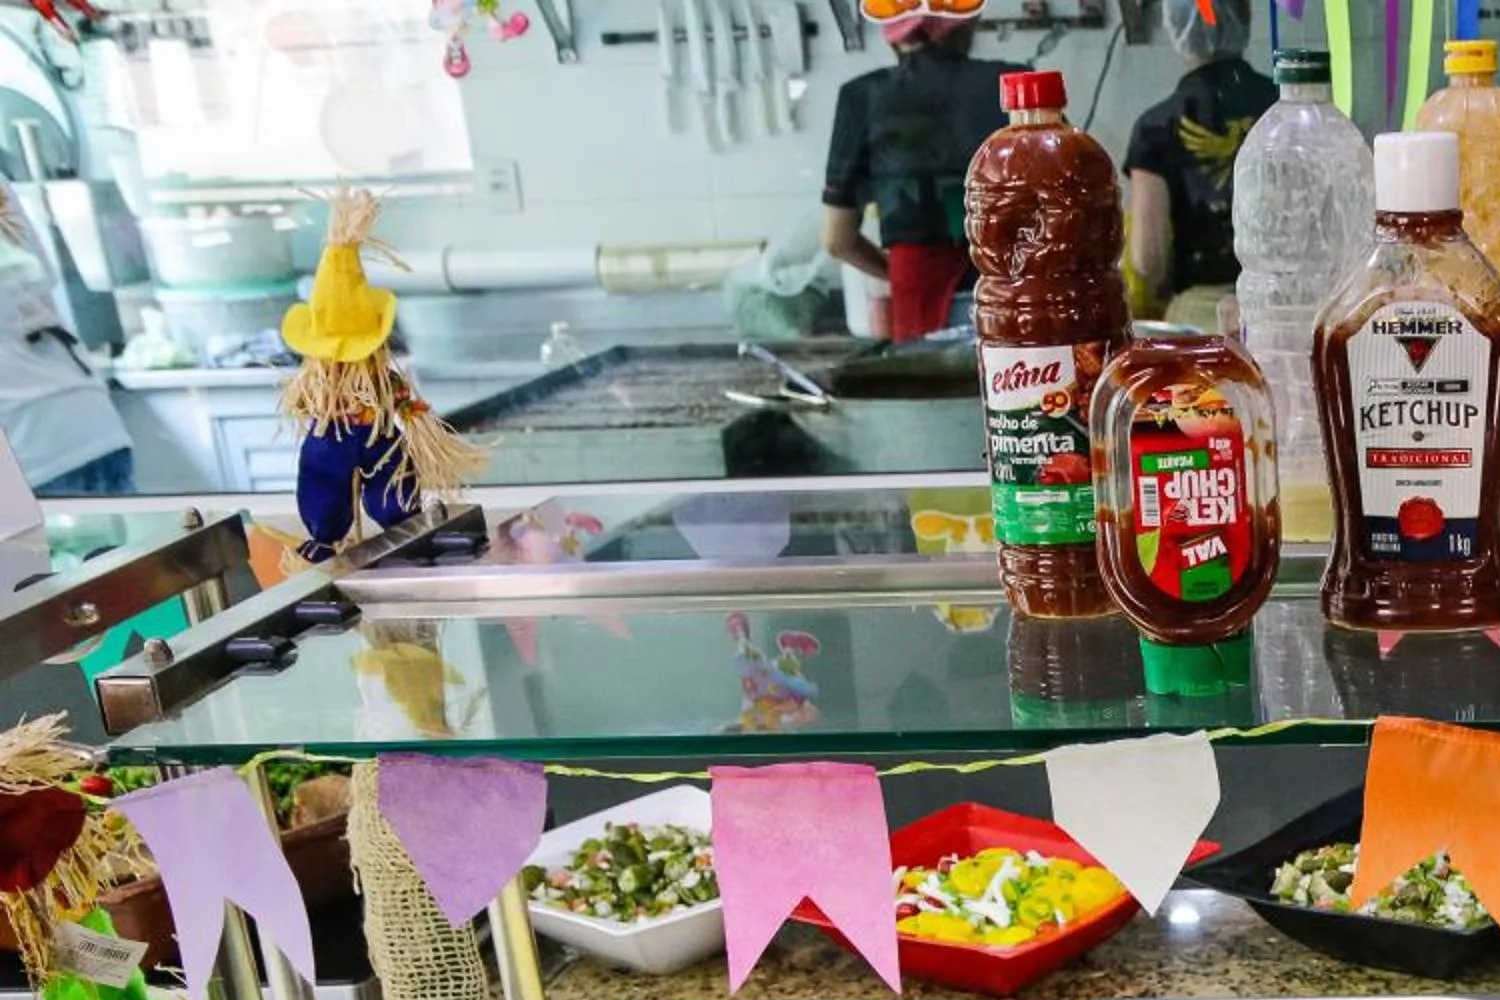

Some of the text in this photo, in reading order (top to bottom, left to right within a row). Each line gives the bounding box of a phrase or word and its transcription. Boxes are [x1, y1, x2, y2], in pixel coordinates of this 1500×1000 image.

[1371, 320, 1464, 335] HEMMER
[1021, 414, 1039, 431] de
[1360, 400, 1479, 431] KETCHUP
[991, 430, 1075, 458] pimenta
[1371, 453, 1468, 464] TRADICIONAL
[1164, 468, 1236, 498] CHUP
[1181, 535, 1228, 567] VAL
[1457, 533, 1471, 556] kg
